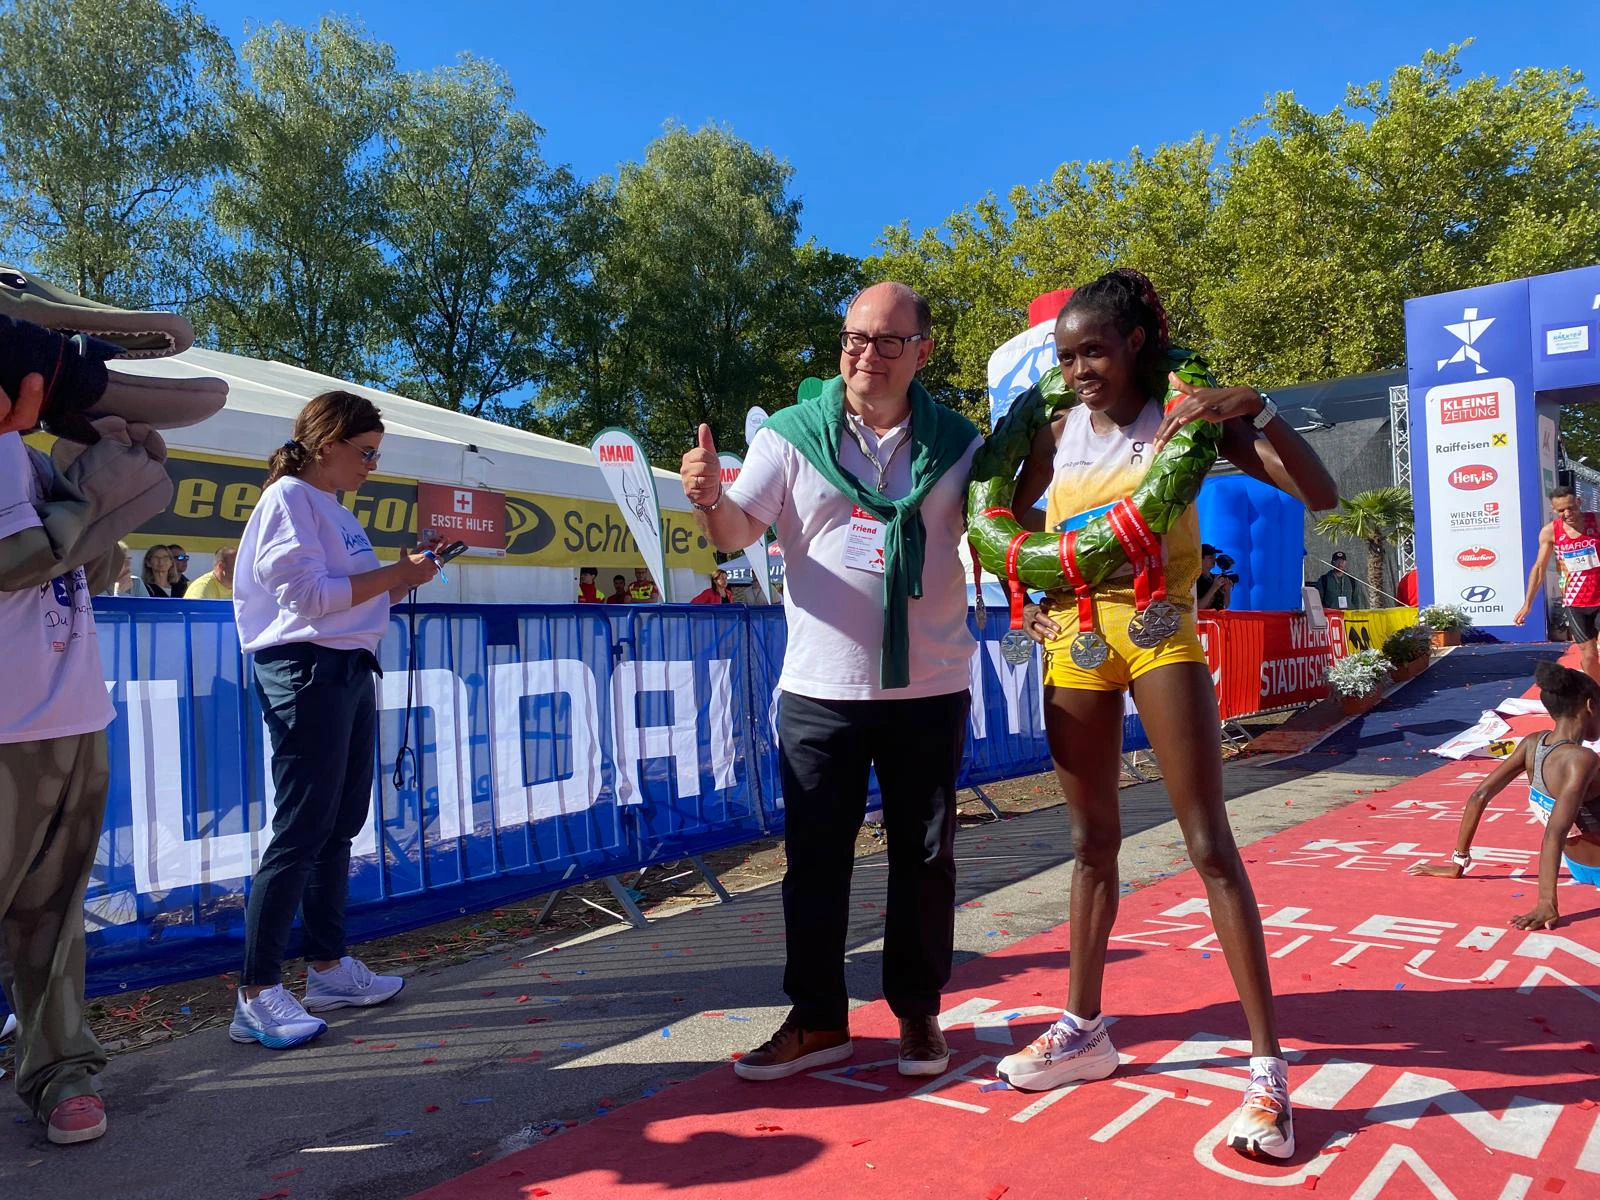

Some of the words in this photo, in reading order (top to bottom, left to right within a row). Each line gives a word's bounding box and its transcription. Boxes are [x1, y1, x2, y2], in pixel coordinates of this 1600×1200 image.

[1443, 396, 1497, 411] KLEINE
[1443, 406, 1497, 422] ZEITUNG
[1435, 441, 1490, 453] Raiffeisen
[1453, 470, 1494, 485] Hervis
[1450, 510, 1484, 519] WIENER
[431, 513, 463, 529] ERSTE
[466, 517, 494, 533] HILFE
[852, 523, 878, 535] Friend
[1560, 539, 1596, 551] MAROC
[726, 568, 746, 580] GET
[45, 610, 69, 628] Du
[1289, 616, 1331, 650] WIENER
